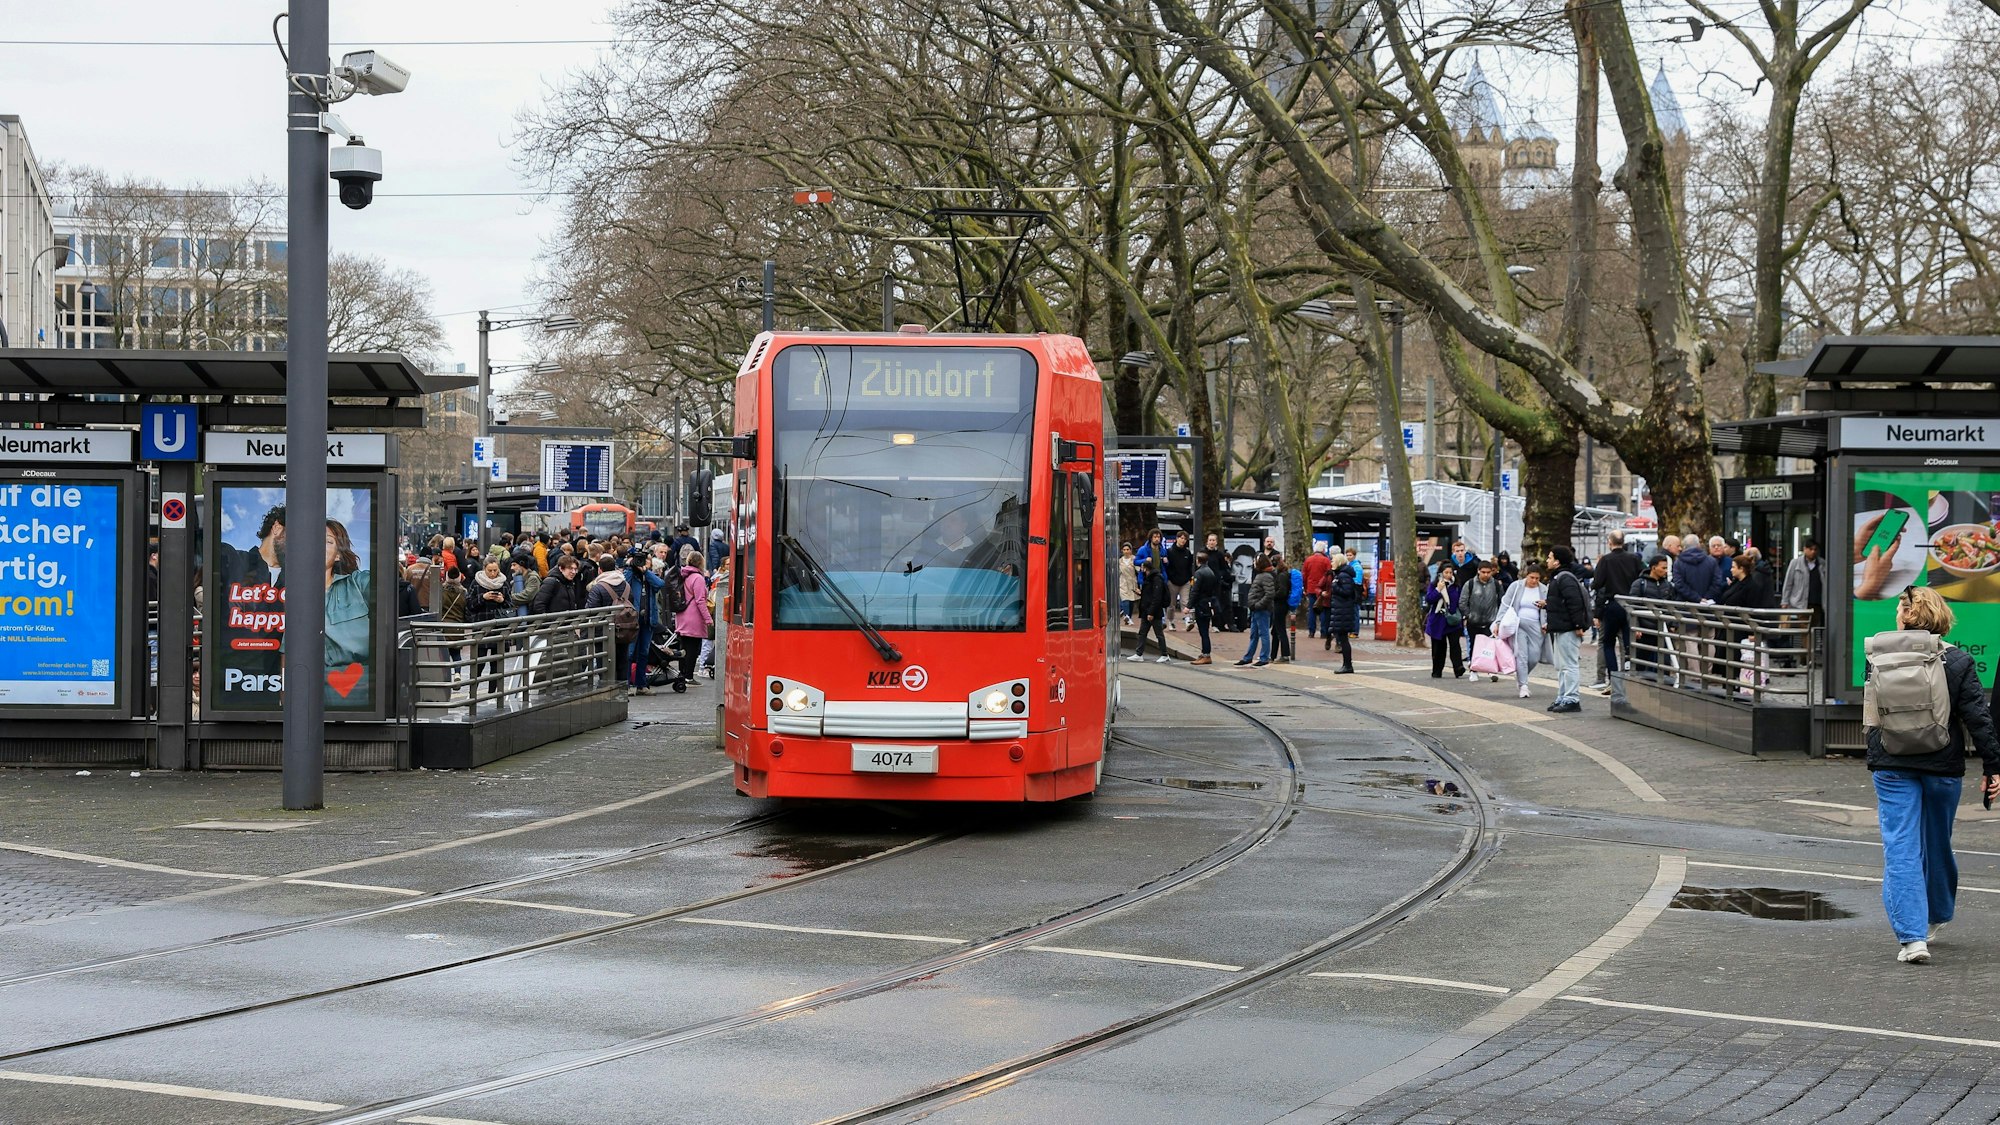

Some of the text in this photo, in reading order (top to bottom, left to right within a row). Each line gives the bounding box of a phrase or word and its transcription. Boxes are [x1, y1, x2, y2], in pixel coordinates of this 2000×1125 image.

[811, 358, 995, 397] 7 Zündorf
[153, 413, 186, 452] U
[1886, 424, 1985, 442] Neumarkt
[246, 439, 344, 457] Neukt
[1924, 458, 1959, 466] JCDecaux
[30, 484, 82, 508] die
[867, 671, 900, 685] KVB
[871, 752, 914, 766] 4074
